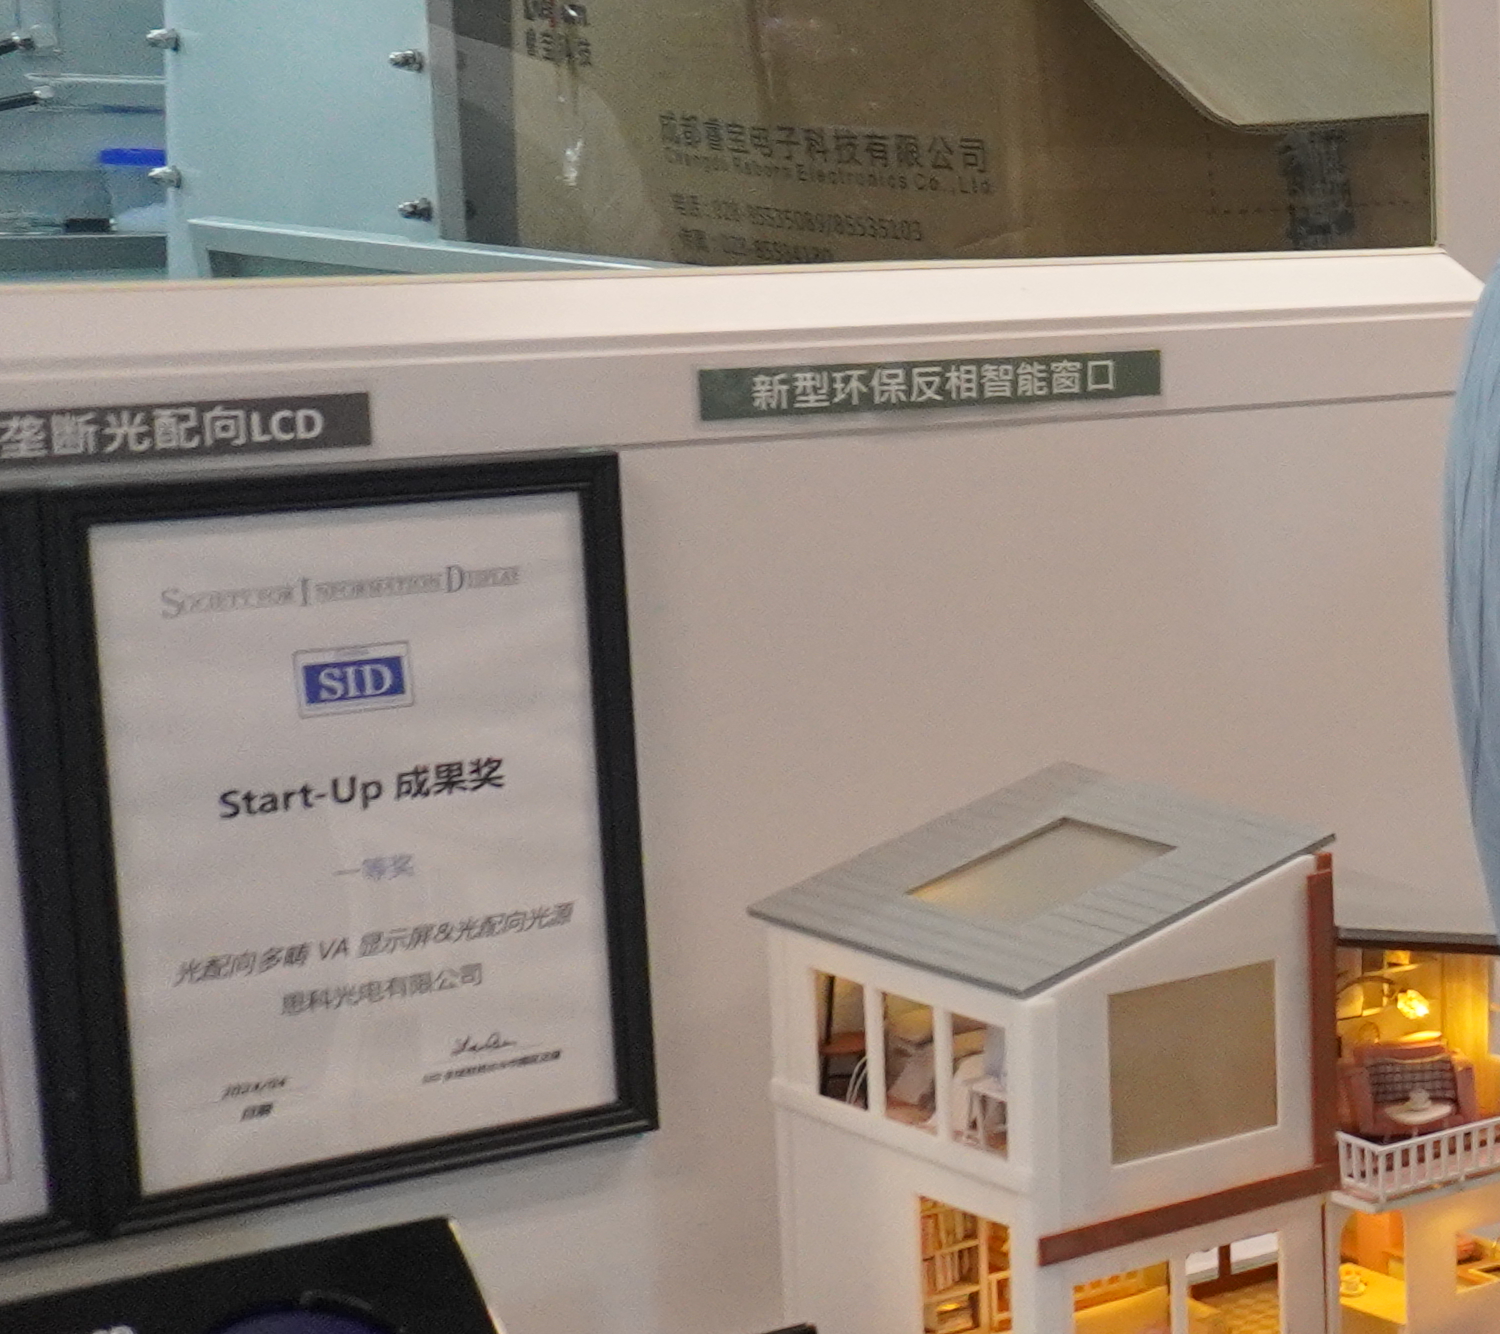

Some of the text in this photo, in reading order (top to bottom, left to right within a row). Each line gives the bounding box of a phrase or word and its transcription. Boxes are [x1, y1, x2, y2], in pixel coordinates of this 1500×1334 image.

[750, 359, 1116, 411] 新型环保反相智能窗口
[317, 663, 395, 703] SID
[218, 757, 505, 820] Start-Up 成果奖
[317, 936, 351, 962] VA
